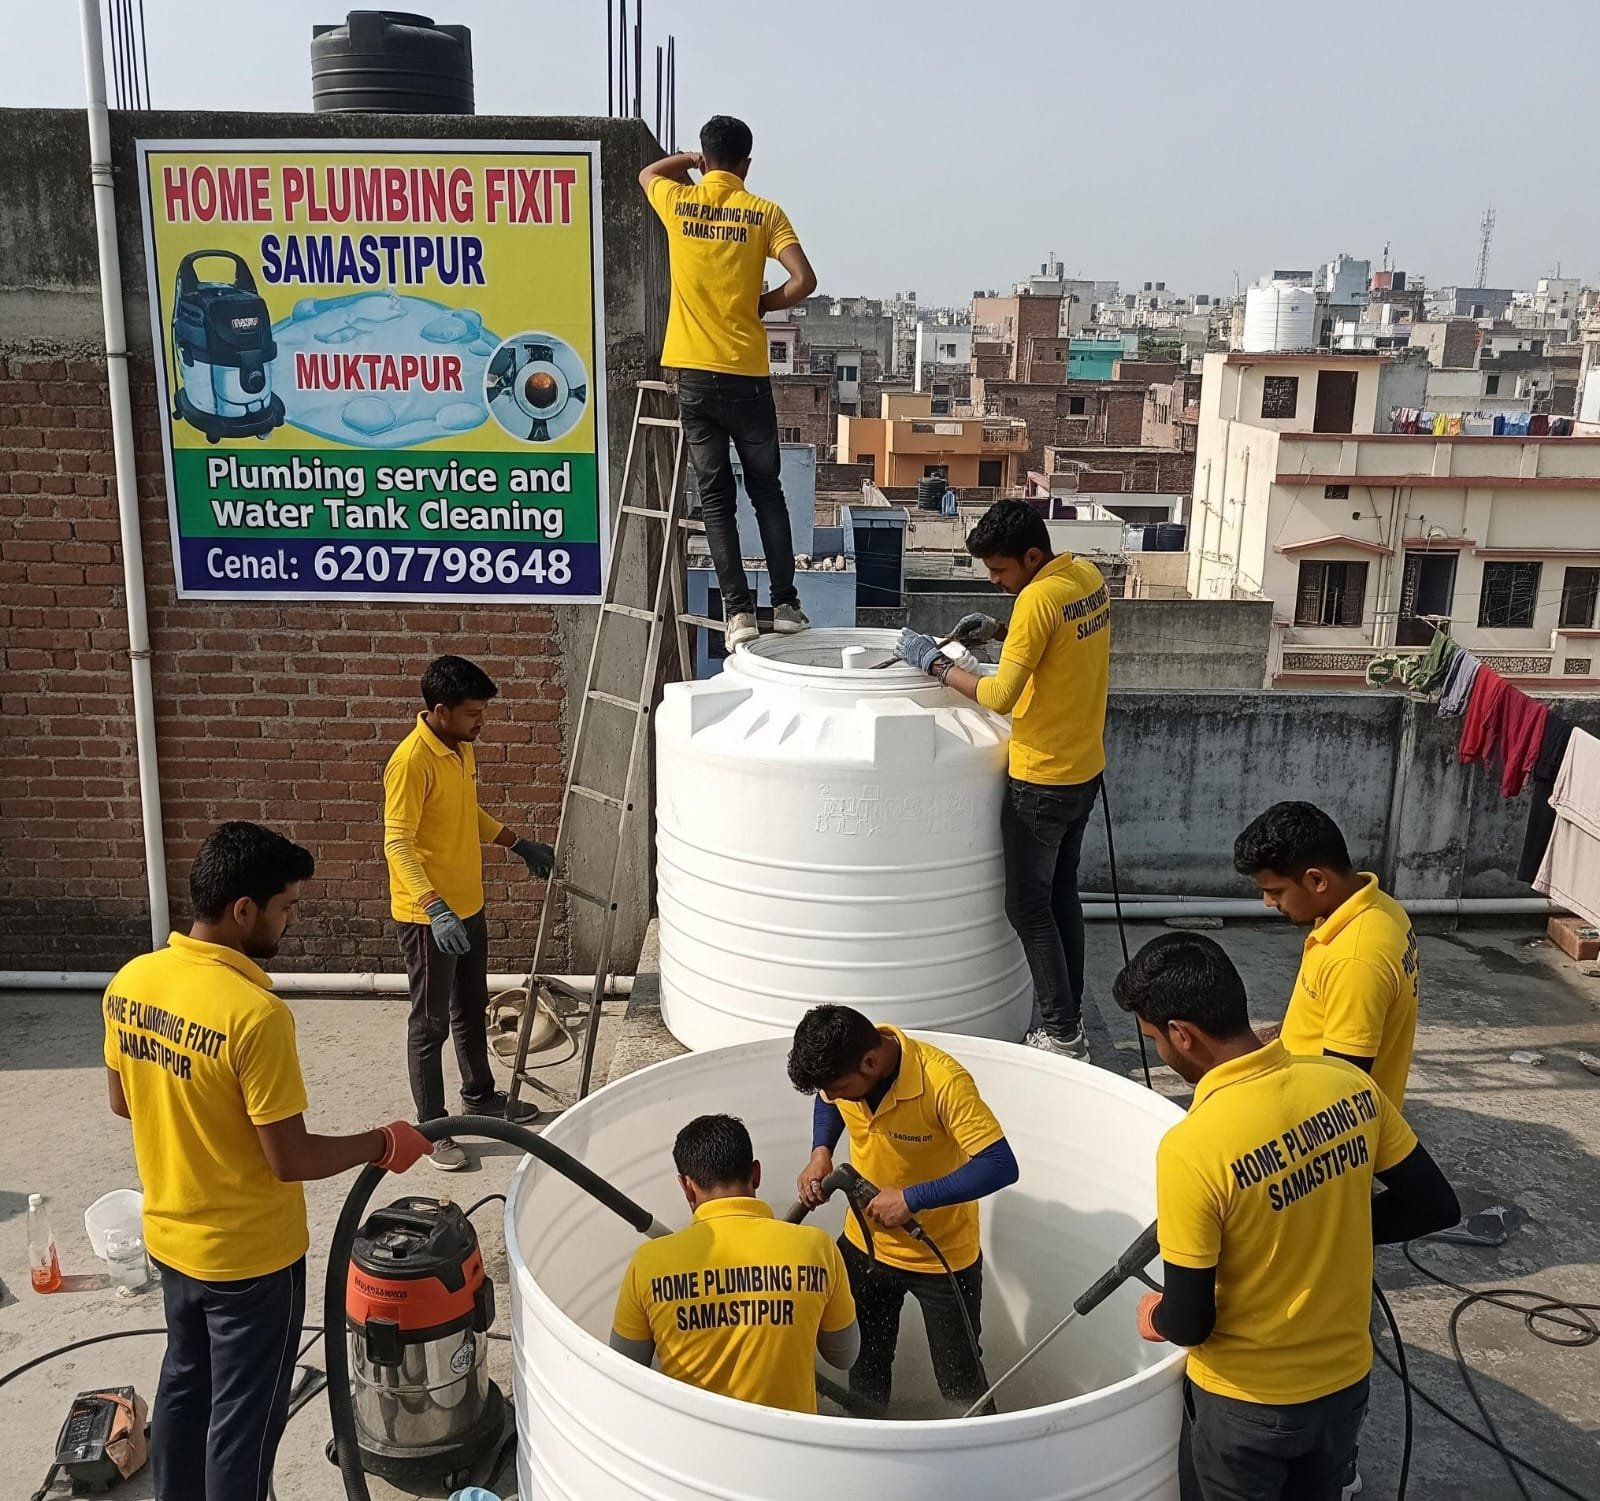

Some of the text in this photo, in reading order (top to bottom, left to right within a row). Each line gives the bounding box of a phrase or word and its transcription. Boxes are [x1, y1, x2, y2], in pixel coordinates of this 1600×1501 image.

[163, 166, 577, 225] HOME PLUMBING FIXIT
[683, 221, 747, 243] SAMASTIPUR
[261, 234, 486, 286] SAMASTIPUR
[295, 352, 463, 392] MUKTAPUR
[207, 457, 571, 496] Plumbing service and
[211, 499, 563, 538] Water Tank Cleaning
[207, 546, 571, 584] Cenal: 6207798648
[184, 1022, 227, 1059] FIXIT
[1230, 1139, 1288, 1190] HOME
[1281, 1098, 1359, 1163] PLUMBING
[1268, 1134, 1369, 1212] SAMASTIPUR
[651, 1271, 700, 1303] HOME
[704, 1264, 792, 1297] PLUMBING
[676, 1299, 794, 1331] SAMASTIPUR
